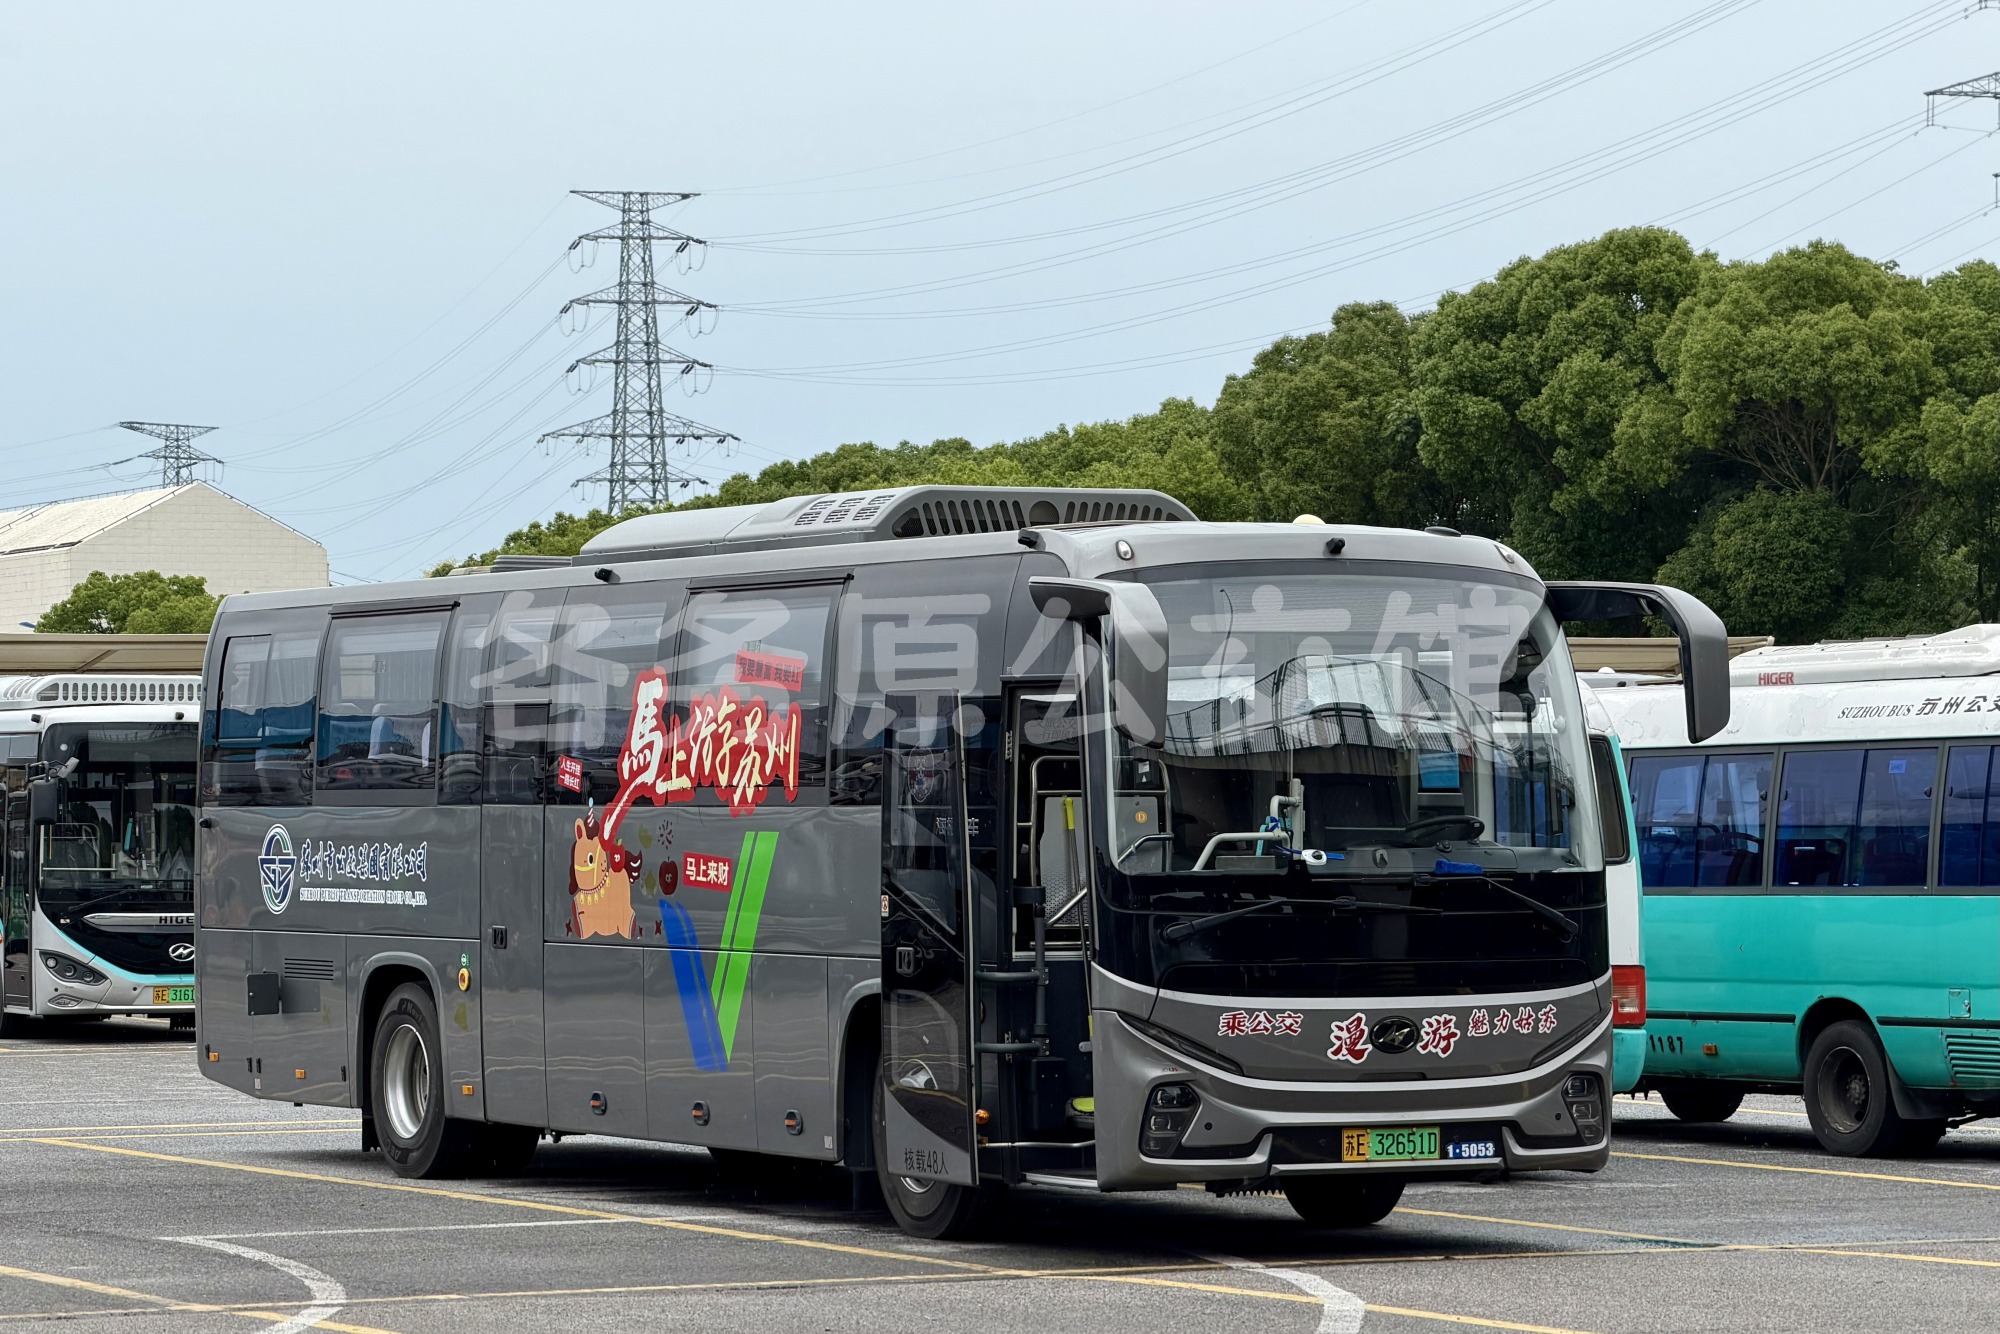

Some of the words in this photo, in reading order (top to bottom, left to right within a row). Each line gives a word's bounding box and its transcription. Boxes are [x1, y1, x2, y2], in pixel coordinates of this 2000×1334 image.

[1758, 671, 1795, 686] HIGER
[1837, 704, 1889, 720] SUZHOU
[1886, 703, 1915, 718] BUS
[685, 857, 729, 886] 马上来财
[299, 887, 321, 902] SUZHOU
[321, 888, 340, 902] PUBLIC
[340, 888, 386, 904] TRANSPORTATION
[386, 890, 404, 905] GROUP
[158, 915, 194, 924] HIGE
[1218, 1010, 1304, 1036] 乘公交
[1467, 1003, 1558, 1037] 魅力姑苏
[1649, 1034, 1683, 1054] 1187
[904, 1147, 949, 1175] 核载48人
